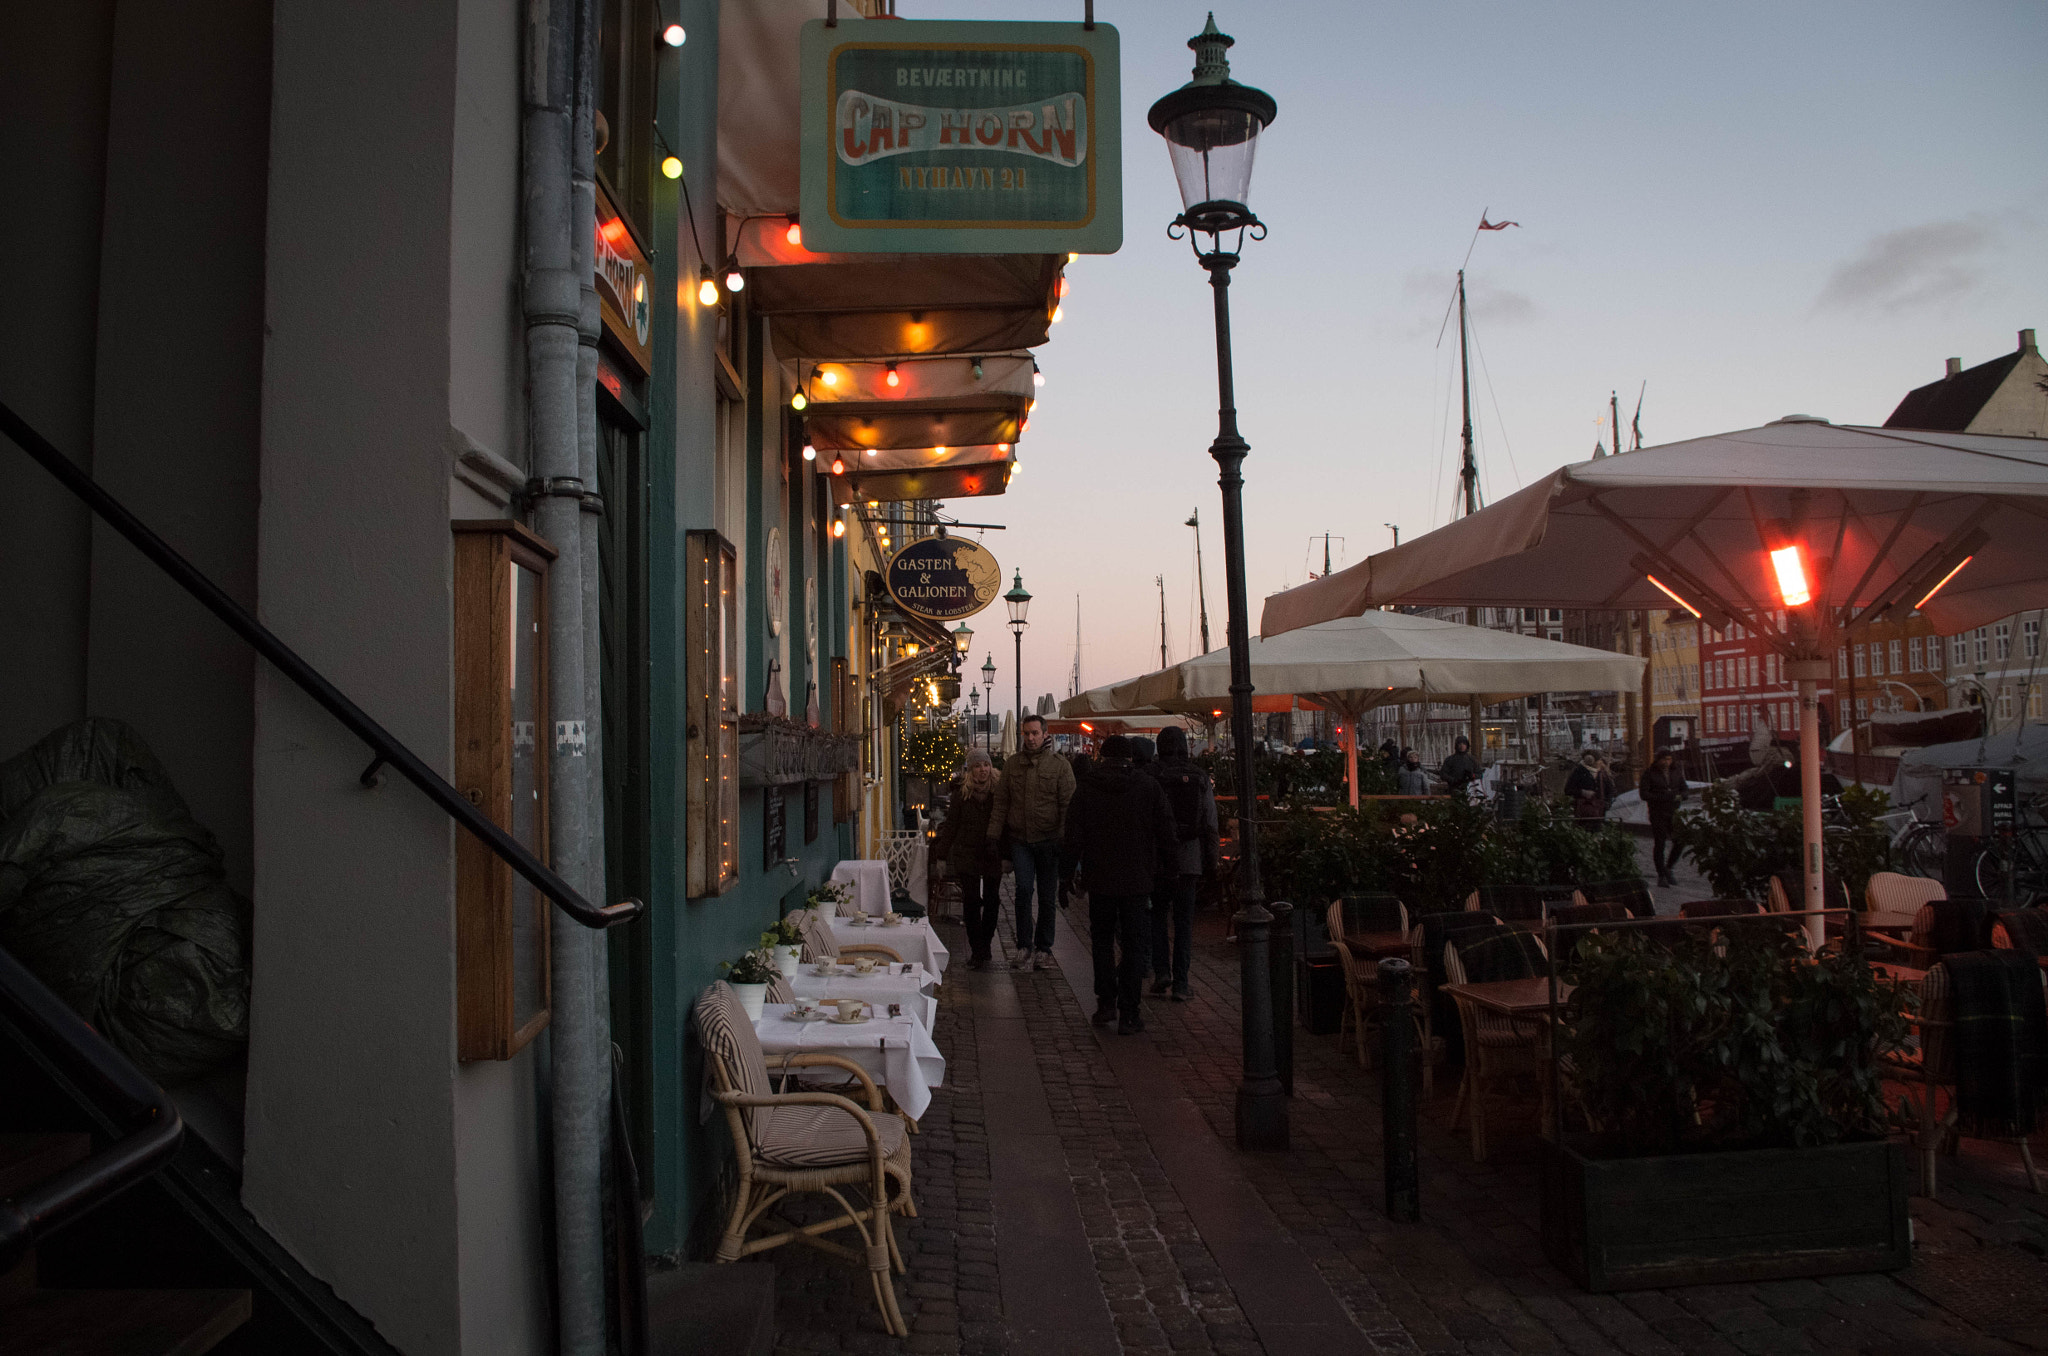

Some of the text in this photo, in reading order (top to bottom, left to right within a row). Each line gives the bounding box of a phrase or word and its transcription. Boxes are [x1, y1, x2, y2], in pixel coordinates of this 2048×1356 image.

[896, 67, 1027, 88] BEVÆRTNING
[843, 97, 1078, 163] CAP HORN
[899, 166, 1028, 190] NYHAVN 21
[897, 558, 952, 571] GASTEN
[919, 572, 931, 584] &
[897, 586, 968, 598] GALIONEN
[911, 602, 934, 615] STEAK
[944, 602, 975, 616] LOBSTER
